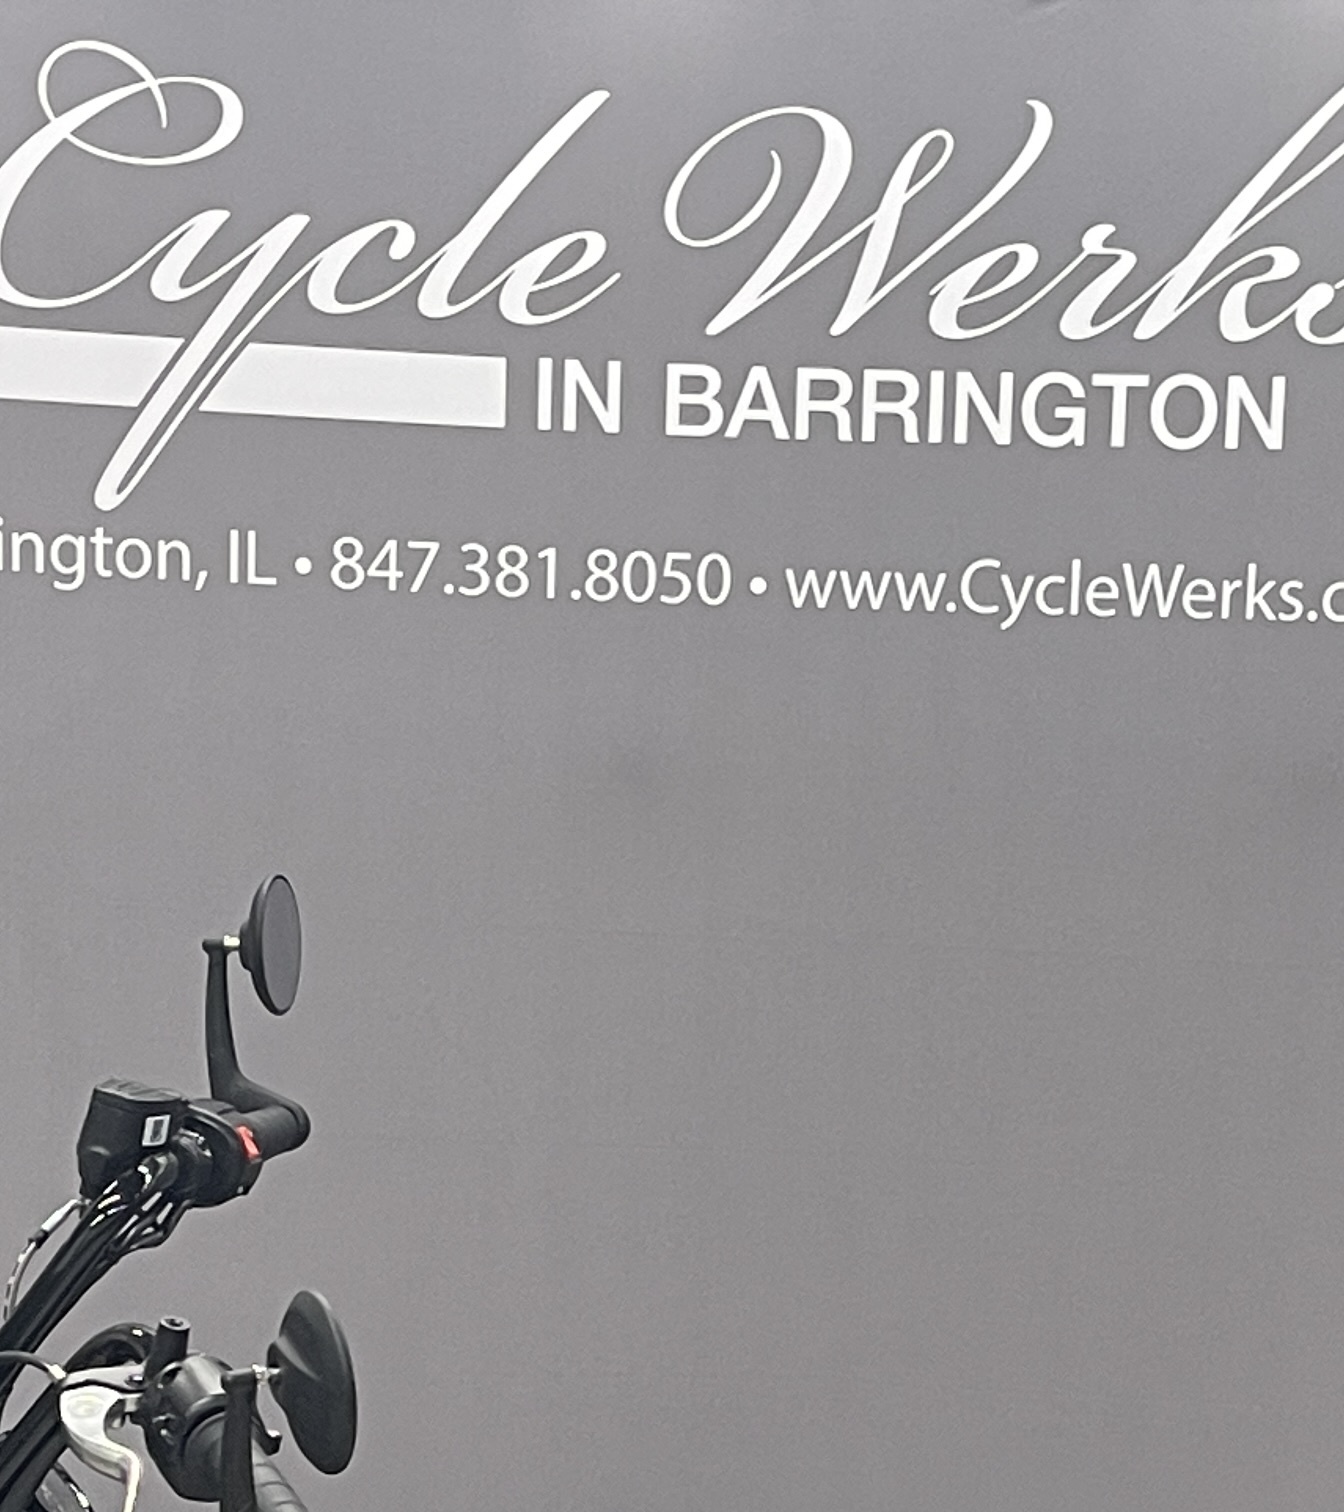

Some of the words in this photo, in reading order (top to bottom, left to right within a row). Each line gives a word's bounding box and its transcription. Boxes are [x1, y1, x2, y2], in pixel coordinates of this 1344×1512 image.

[536, 357, 623, 435] IN
[664, 363, 1287, 451] BARRINGTON
[228, 529, 278, 587] IL
[329, 536, 732, 606] 847.381.8050
